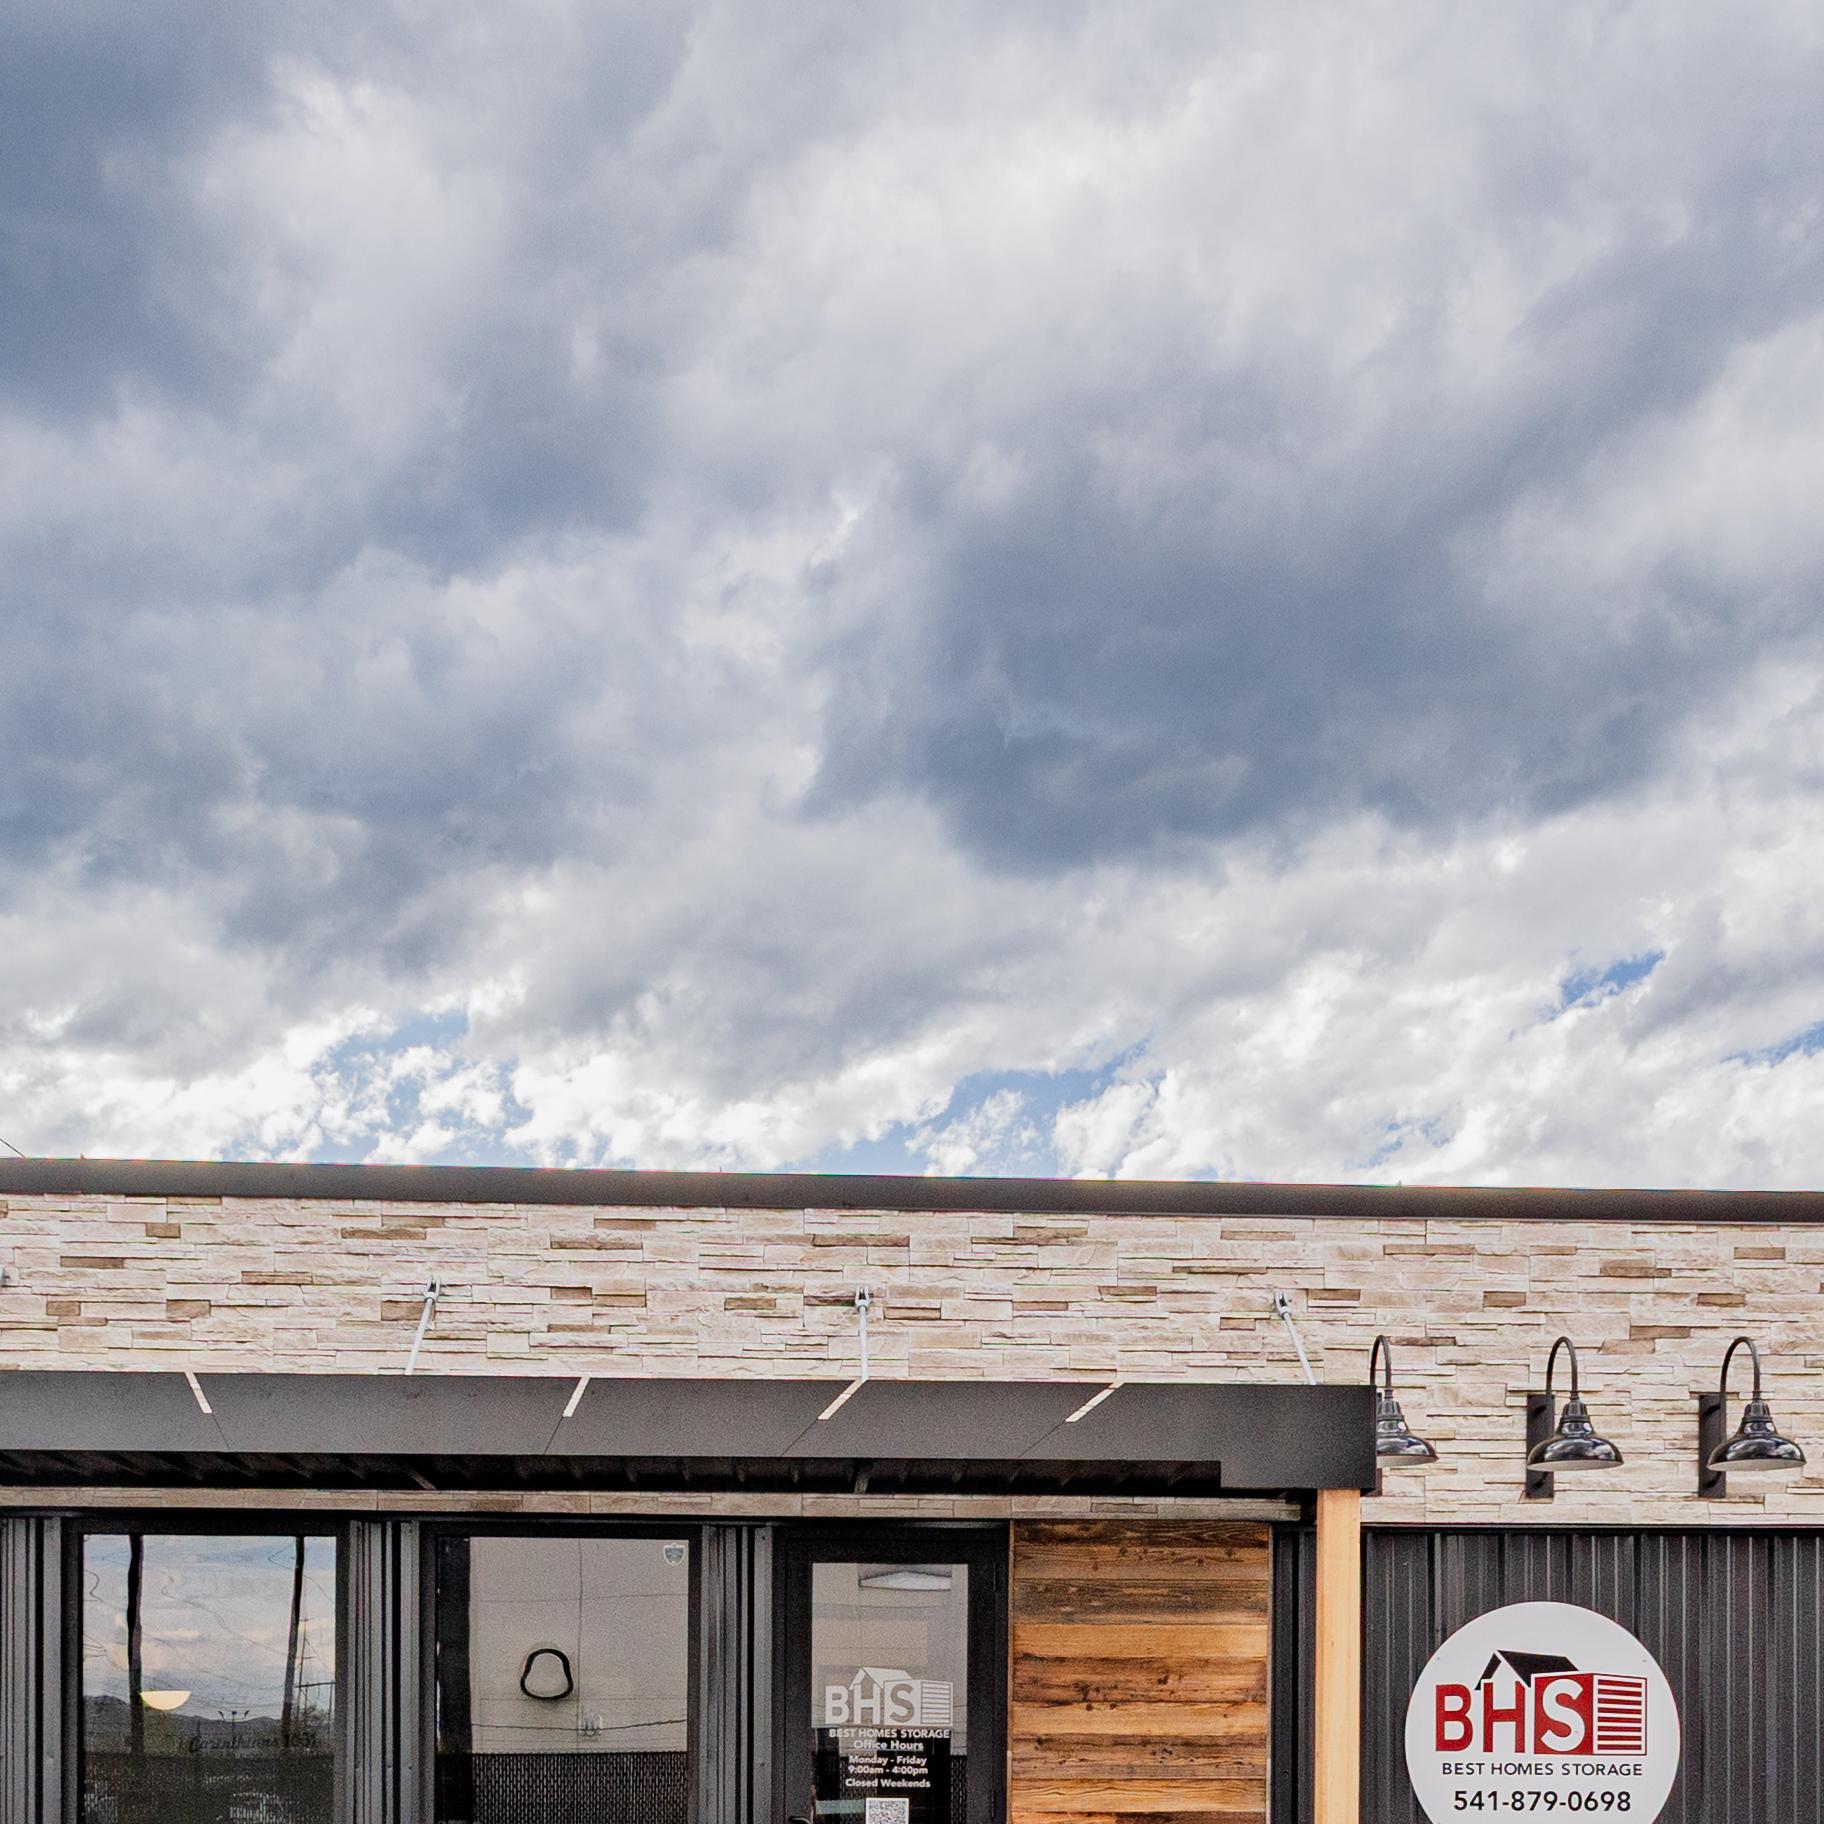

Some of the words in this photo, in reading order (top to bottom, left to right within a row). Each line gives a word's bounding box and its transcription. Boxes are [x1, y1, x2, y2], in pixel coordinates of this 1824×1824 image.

[825, 1683, 915, 1725] BHS
[1435, 1677, 1586, 1754] BHS
[829, 1729, 856, 1738] BEST
[858, 1729, 897, 1738] HOMES
[901, 1729, 950, 1739] STORAGE
[854, 1740, 888, 1750] Office
[891, 1740, 924, 1750] Hours
[848, 1755, 889, 1766] Monday
[896, 1756, 927, 1766] Friday
[848, 1765, 884, 1774] 9:00am
[892, 1766, 928, 1776] 4:00pm
[1442, 1762, 1485, 1775] BEST
[1491, 1762, 1554, 1776] HOMES
[1561, 1763, 1643, 1776] STORAGE
[845, 1778, 878, 1787] Closed
[880, 1779, 931, 1788] Weekends
[1453, 1791, 1632, 1812] 541-879-0698
